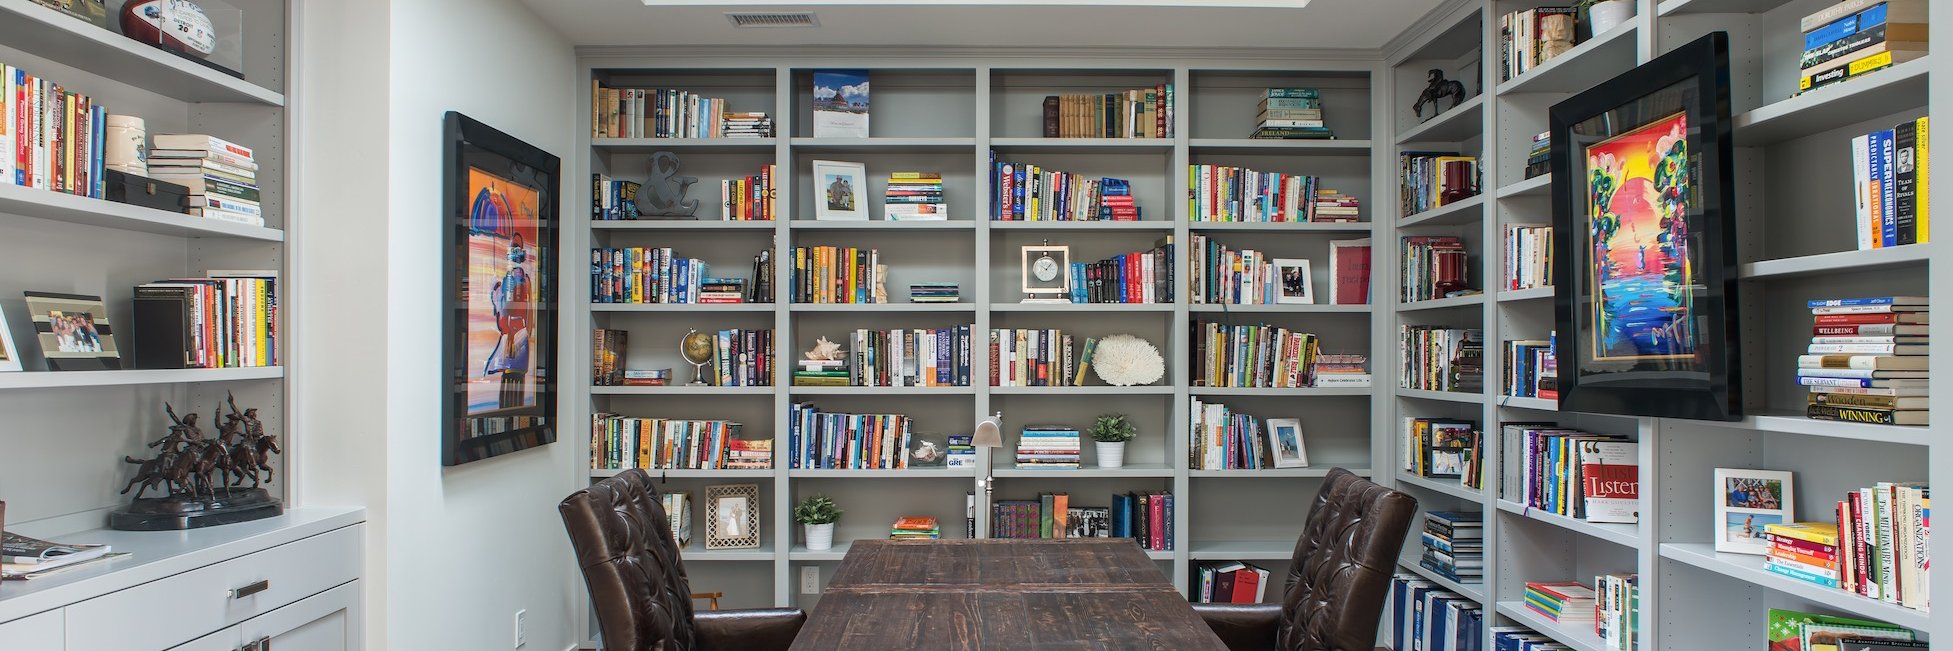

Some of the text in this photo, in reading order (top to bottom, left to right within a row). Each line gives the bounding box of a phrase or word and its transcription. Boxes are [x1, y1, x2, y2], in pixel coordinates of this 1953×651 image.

[178, 24, 188, 32] 20
[1816, 69, 1844, 82] Investing
[1883, 138, 1894, 225] SUPERFREAKONOMICS
[1828, 395, 1866, 406] Wooden
[1840, 409, 1883, 424] WINNING
[1776, 536, 1793, 544] Strategy
[1856, 519, 1864, 552] CHANGING
[1880, 517, 1891, 565] MILLIONAIRE
[1914, 504, 1925, 569] ORGANIZATIONS
[1775, 549, 1796, 560] Leadership
[1778, 542, 1814, 556] Managing Yourself
[1775, 565, 1790, 574] Change
